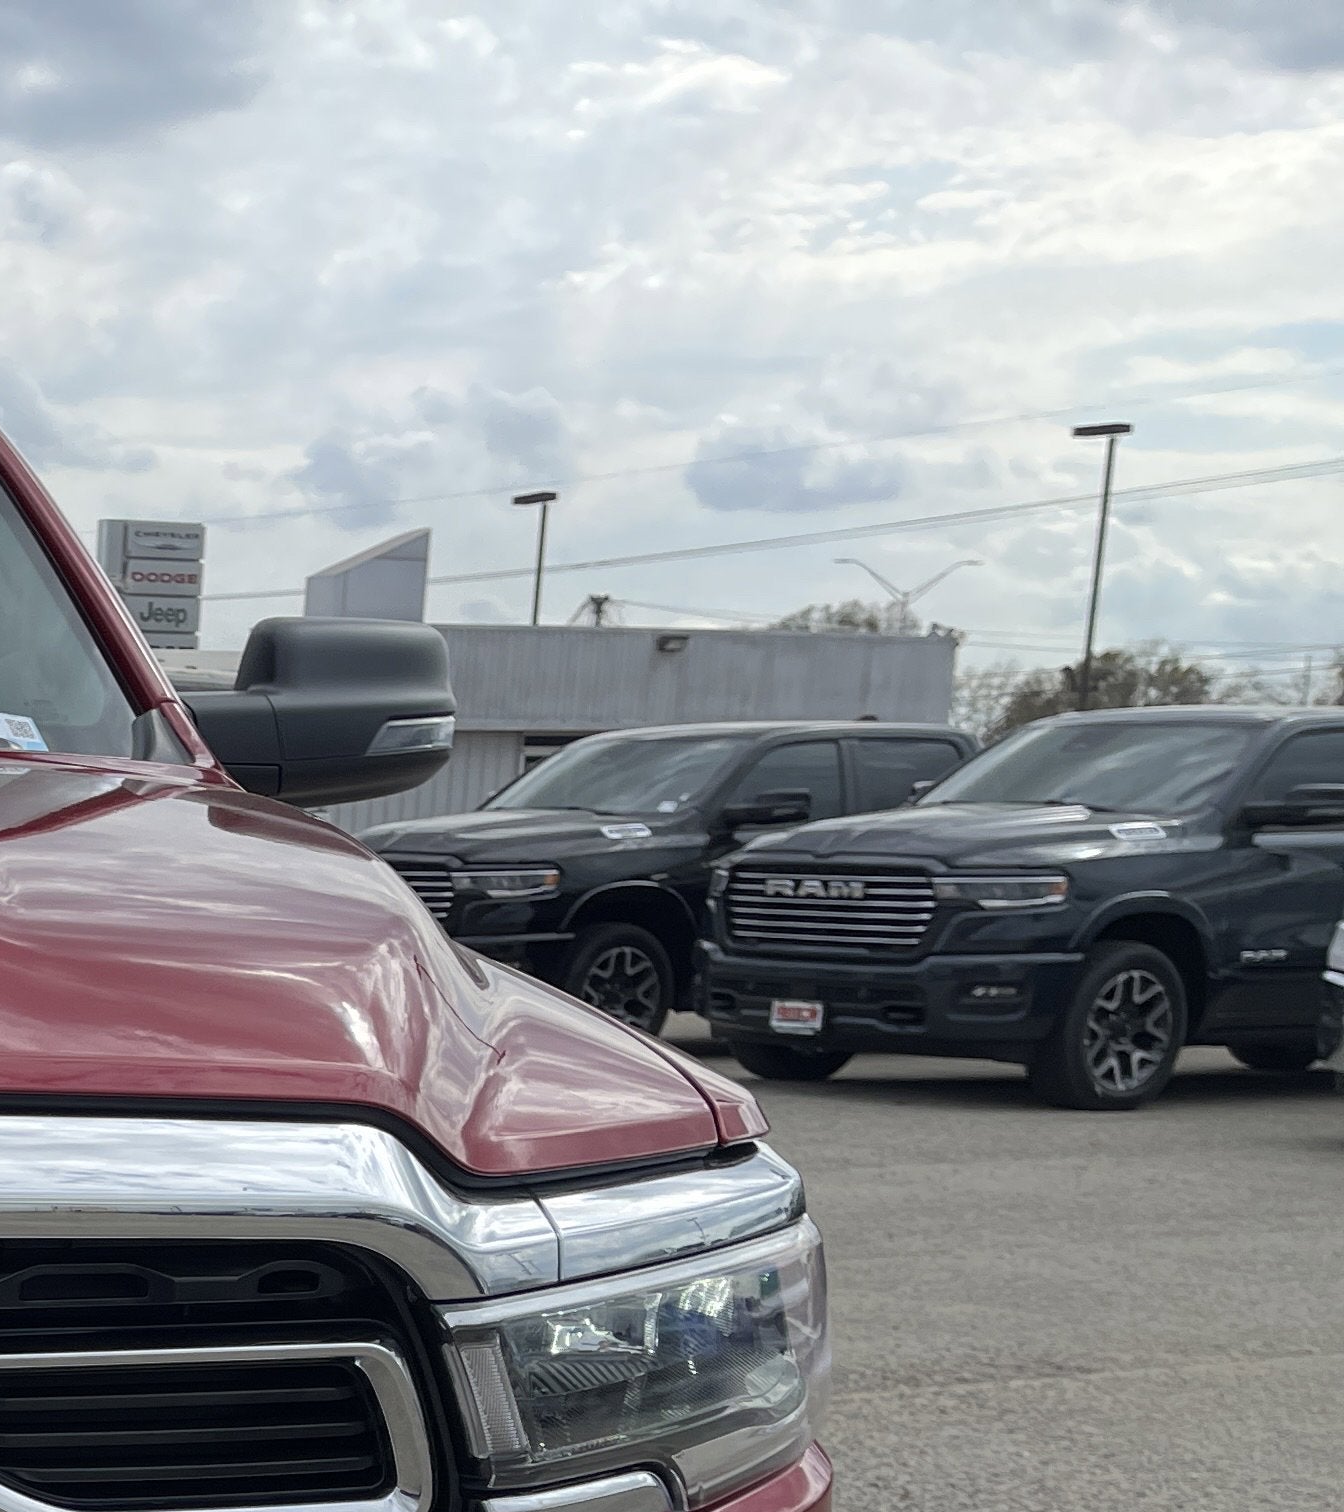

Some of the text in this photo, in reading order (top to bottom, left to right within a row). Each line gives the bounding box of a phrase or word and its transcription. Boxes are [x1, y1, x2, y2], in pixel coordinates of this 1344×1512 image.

[131, 571, 197, 585] DODGE
[139, 601, 187, 628] Jeep
[765, 879, 865, 898] RAM
